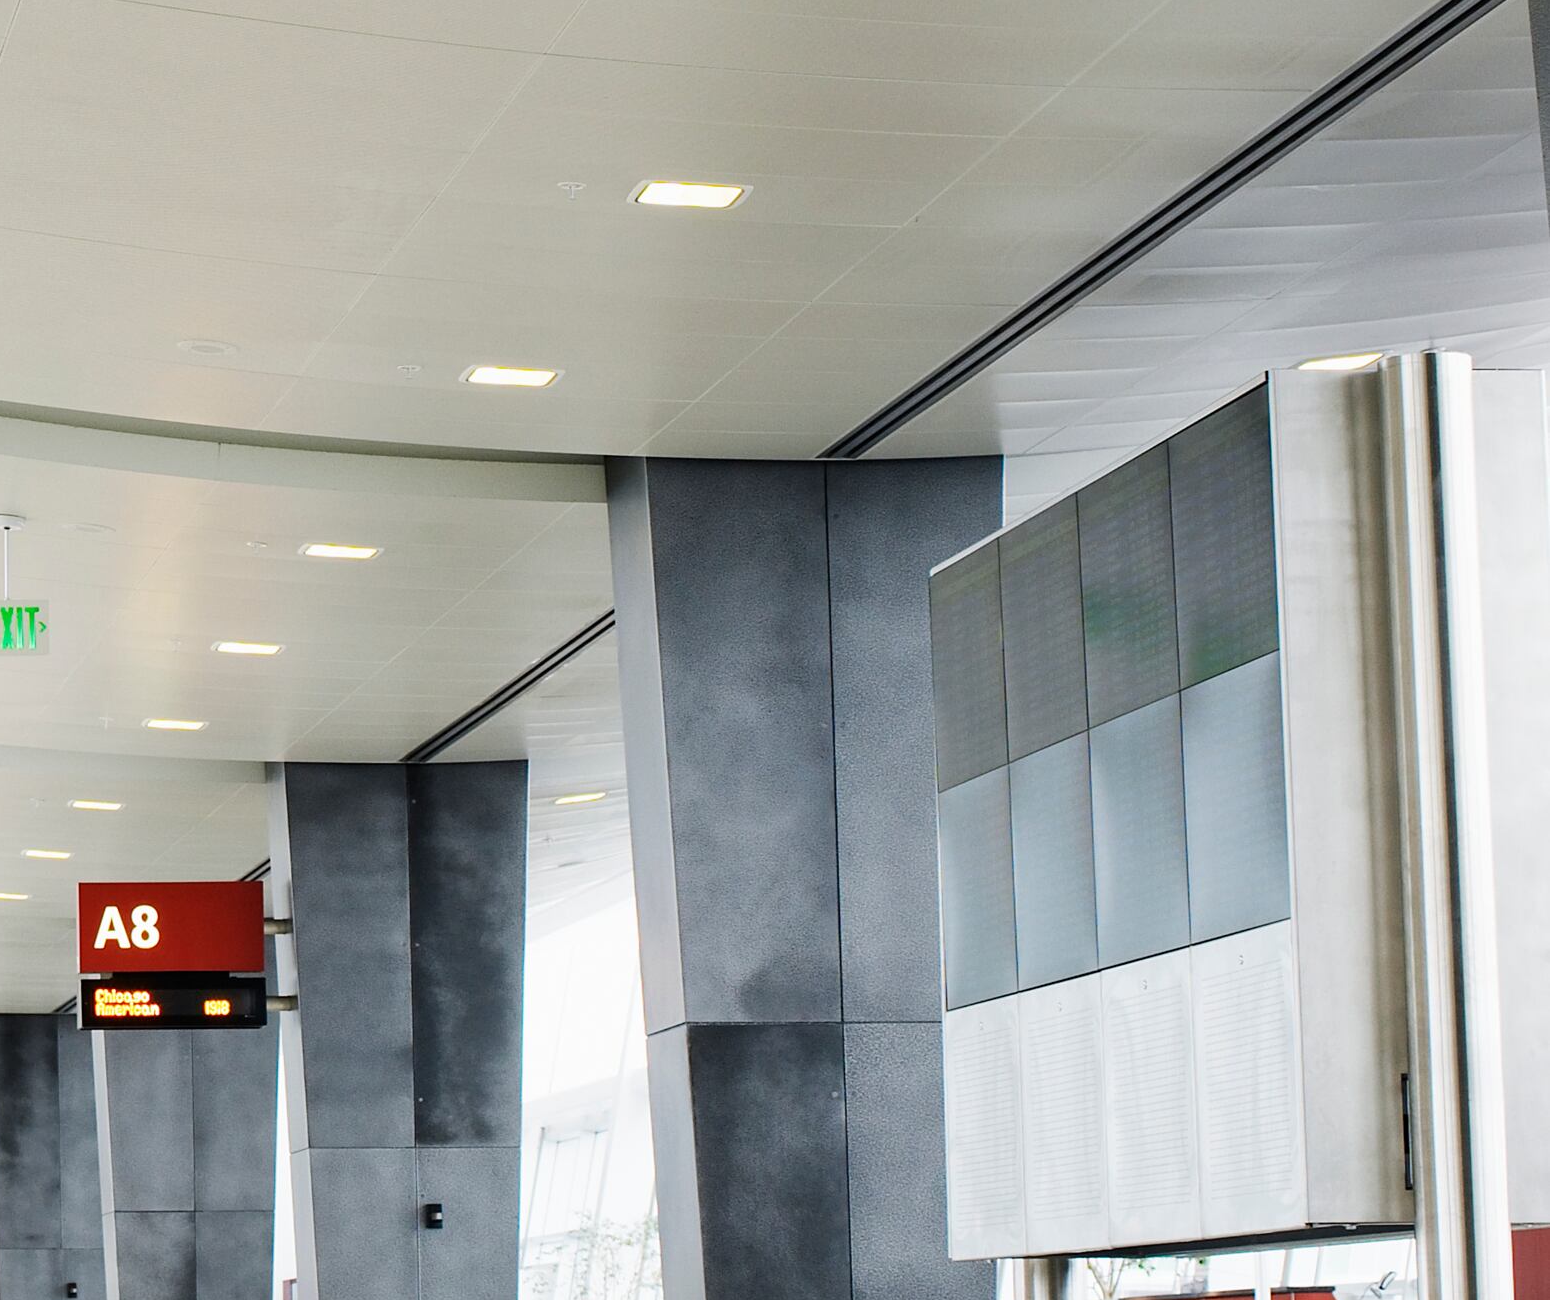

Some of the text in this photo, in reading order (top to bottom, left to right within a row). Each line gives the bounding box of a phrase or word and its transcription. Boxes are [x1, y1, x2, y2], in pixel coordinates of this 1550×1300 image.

[93, 904, 160, 949] A8
[94, 988, 150, 1004] Chicago
[94, 1002, 161, 1017] American
